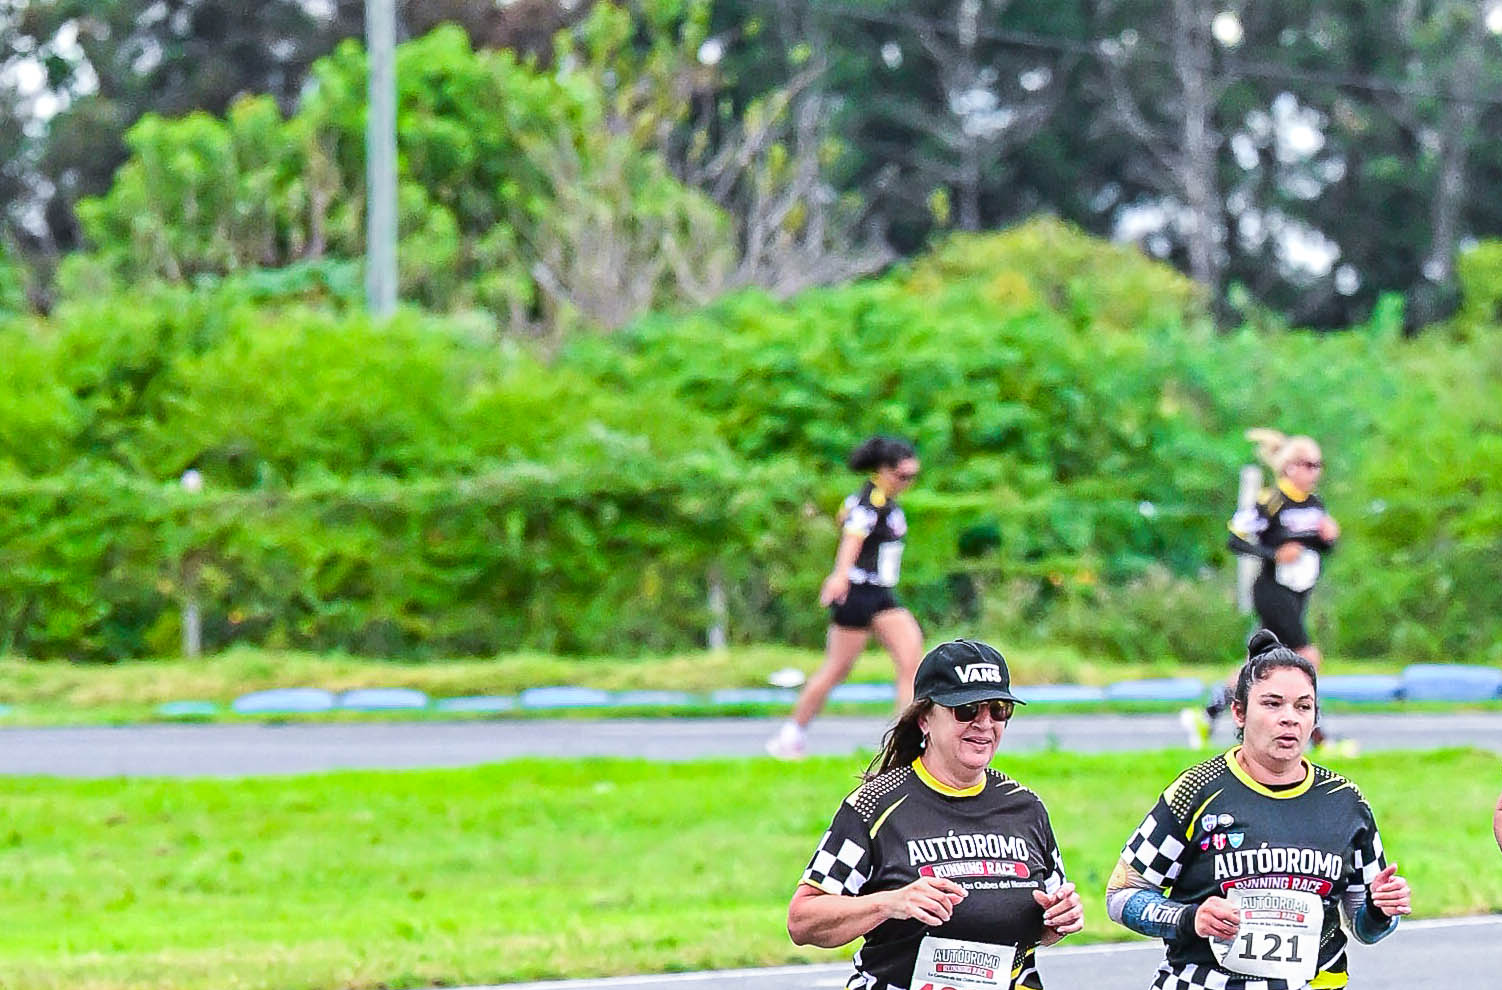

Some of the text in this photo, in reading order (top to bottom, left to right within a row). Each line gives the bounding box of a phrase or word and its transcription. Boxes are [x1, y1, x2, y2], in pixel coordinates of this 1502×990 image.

[954, 663, 1002, 683] VANS
[907, 829, 1029, 867] AUTÓDROMO
[933, 860, 1017, 878] RUNNING RACE
[1214, 841, 1343, 881] AUTÓDROMO
[1291, 877, 1324, 893] RACE
[1240, 893, 1311, 913] AUTÓDROMO
[932, 946, 1001, 970] AUTÓDROMO
[1238, 932, 1303, 963] 121
